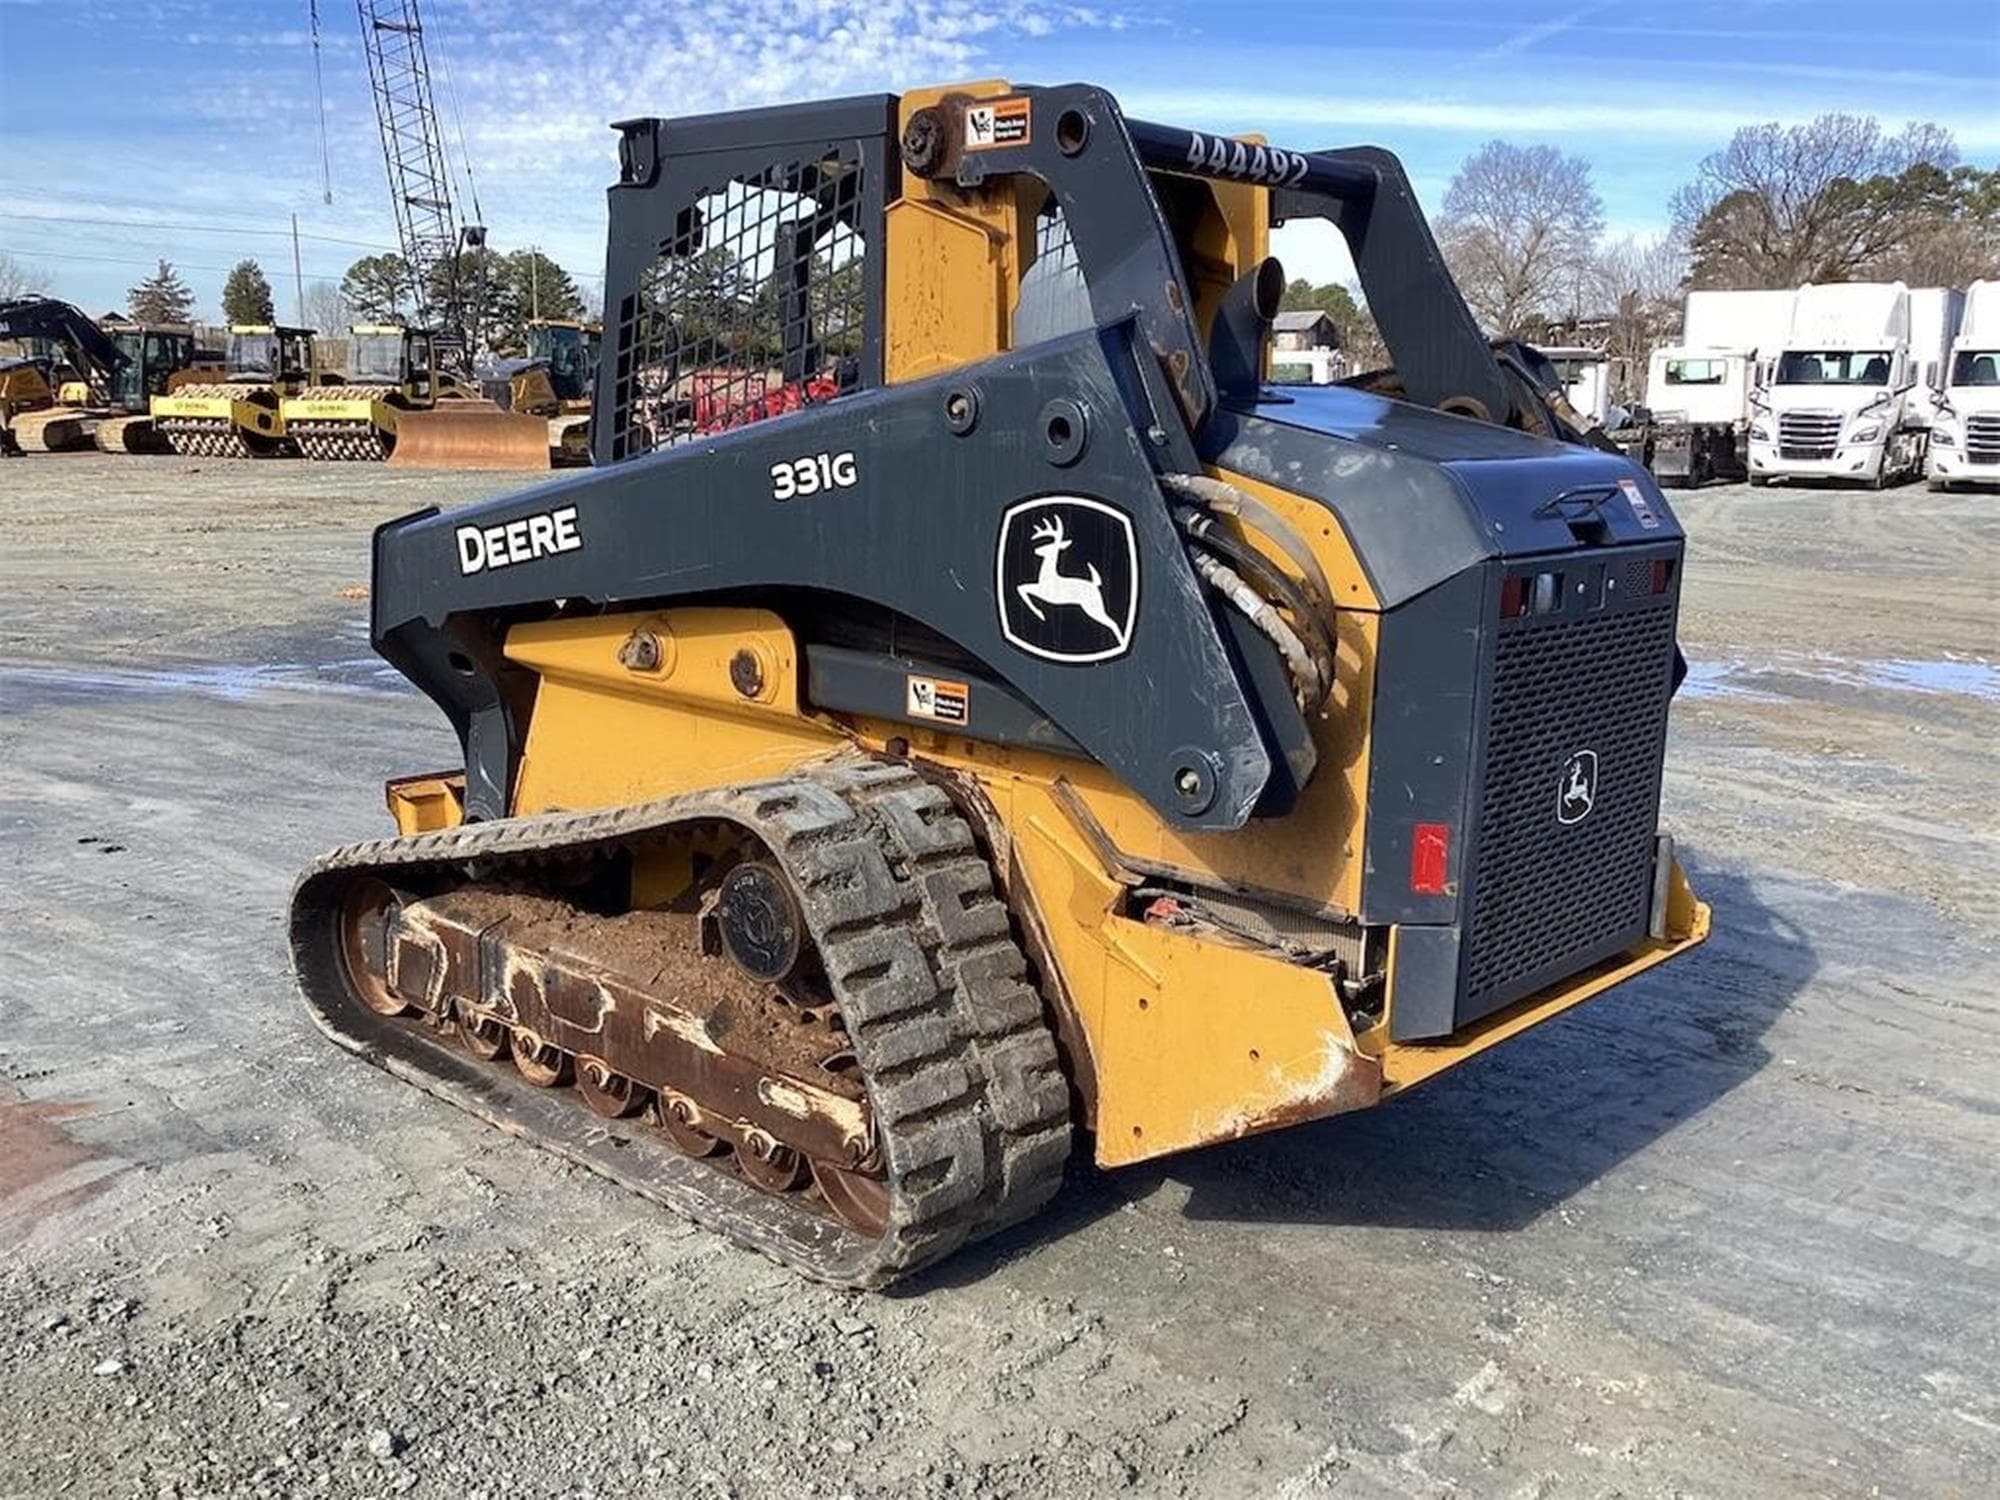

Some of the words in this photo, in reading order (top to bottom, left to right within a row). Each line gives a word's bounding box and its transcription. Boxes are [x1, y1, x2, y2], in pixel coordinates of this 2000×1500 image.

[1187, 132, 1309, 188] 444492
[770, 451, 858, 501] 331G
[455, 506, 582, 575] DEERE
